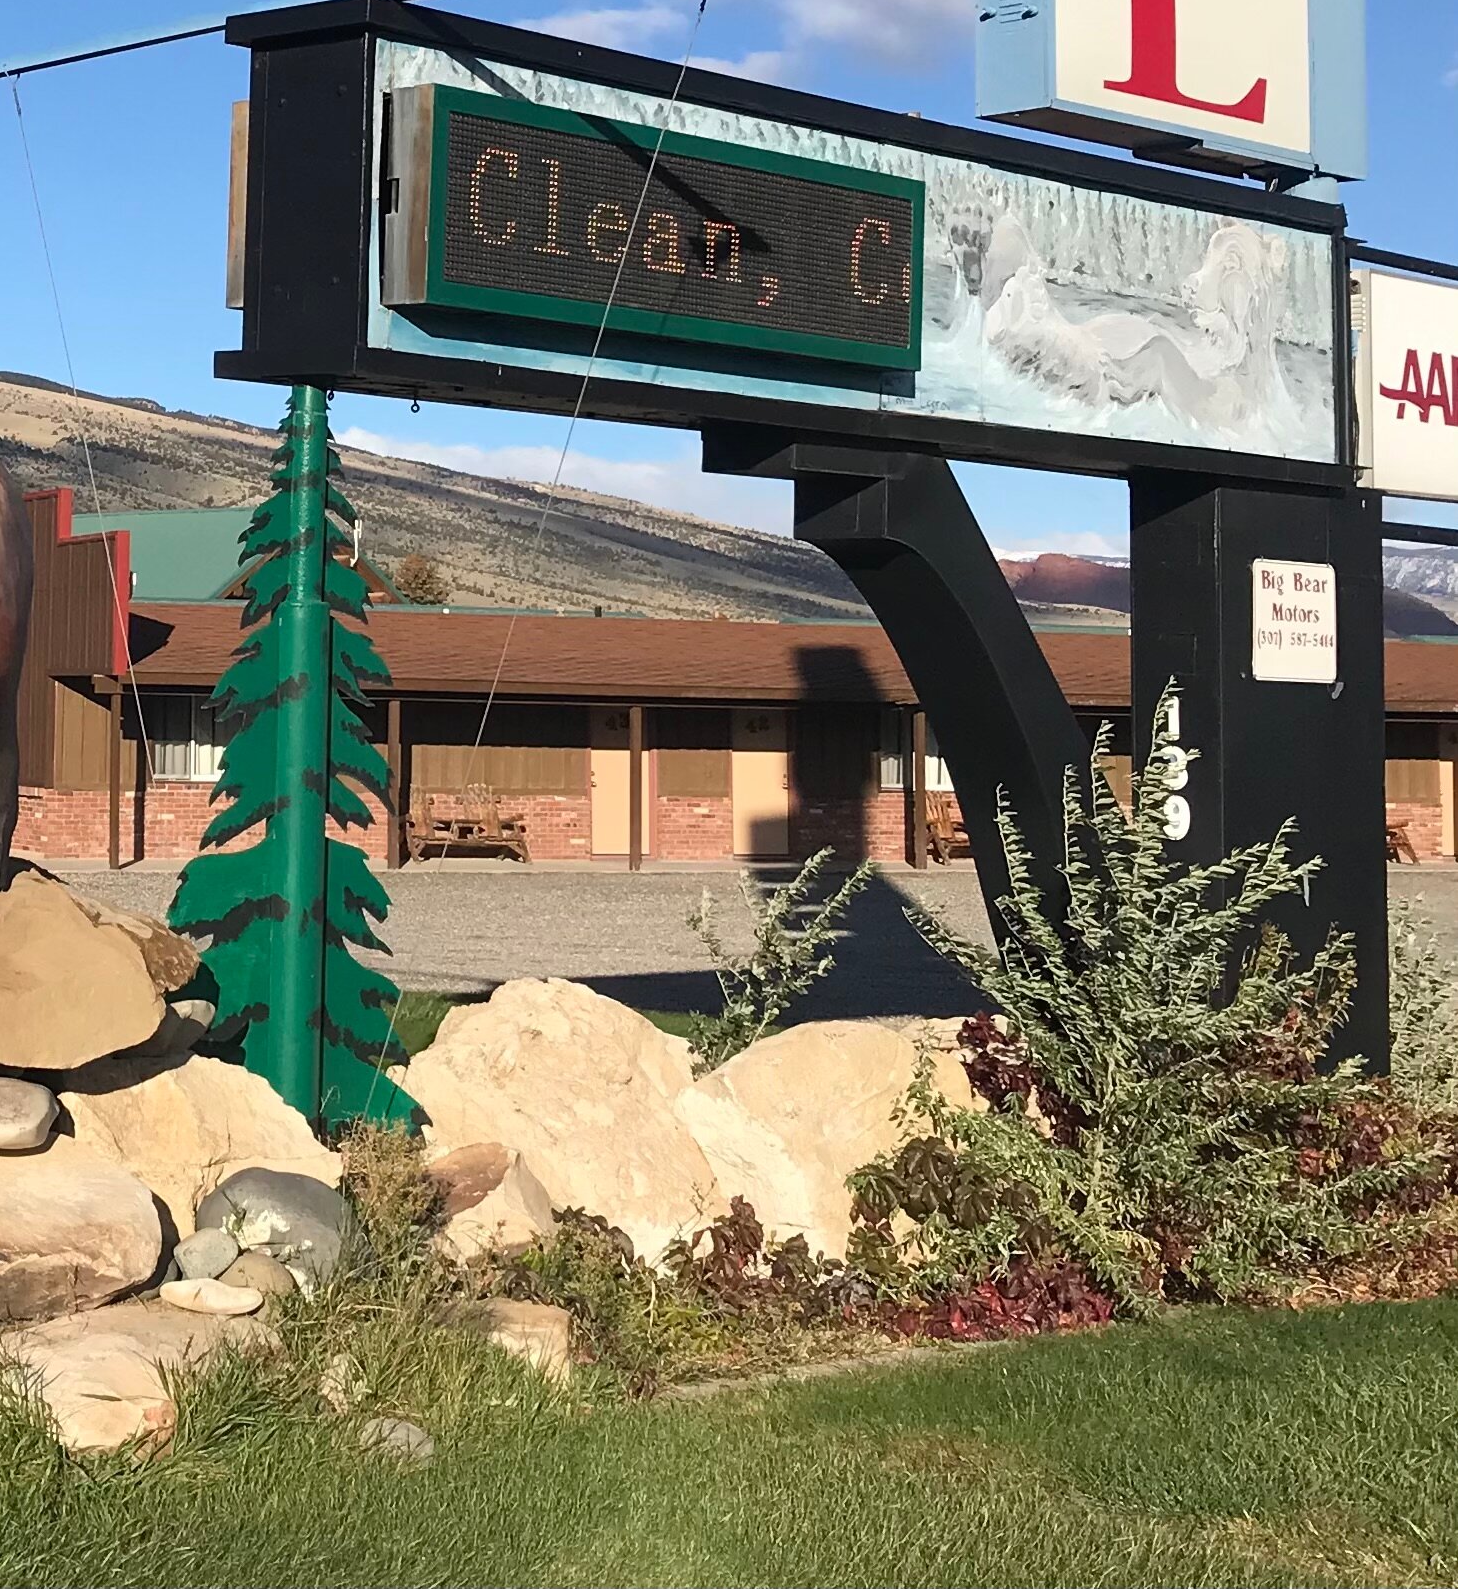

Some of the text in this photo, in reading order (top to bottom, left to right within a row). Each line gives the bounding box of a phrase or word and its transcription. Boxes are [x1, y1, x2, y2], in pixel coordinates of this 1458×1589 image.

[469, 146, 779, 307] Clean,
[1379, 348, 1458, 428] AA
[1261, 569, 1328, 596] Big Bear
[1271, 602, 1320, 624] Motors
[1257, 628, 1283, 651] (307)
